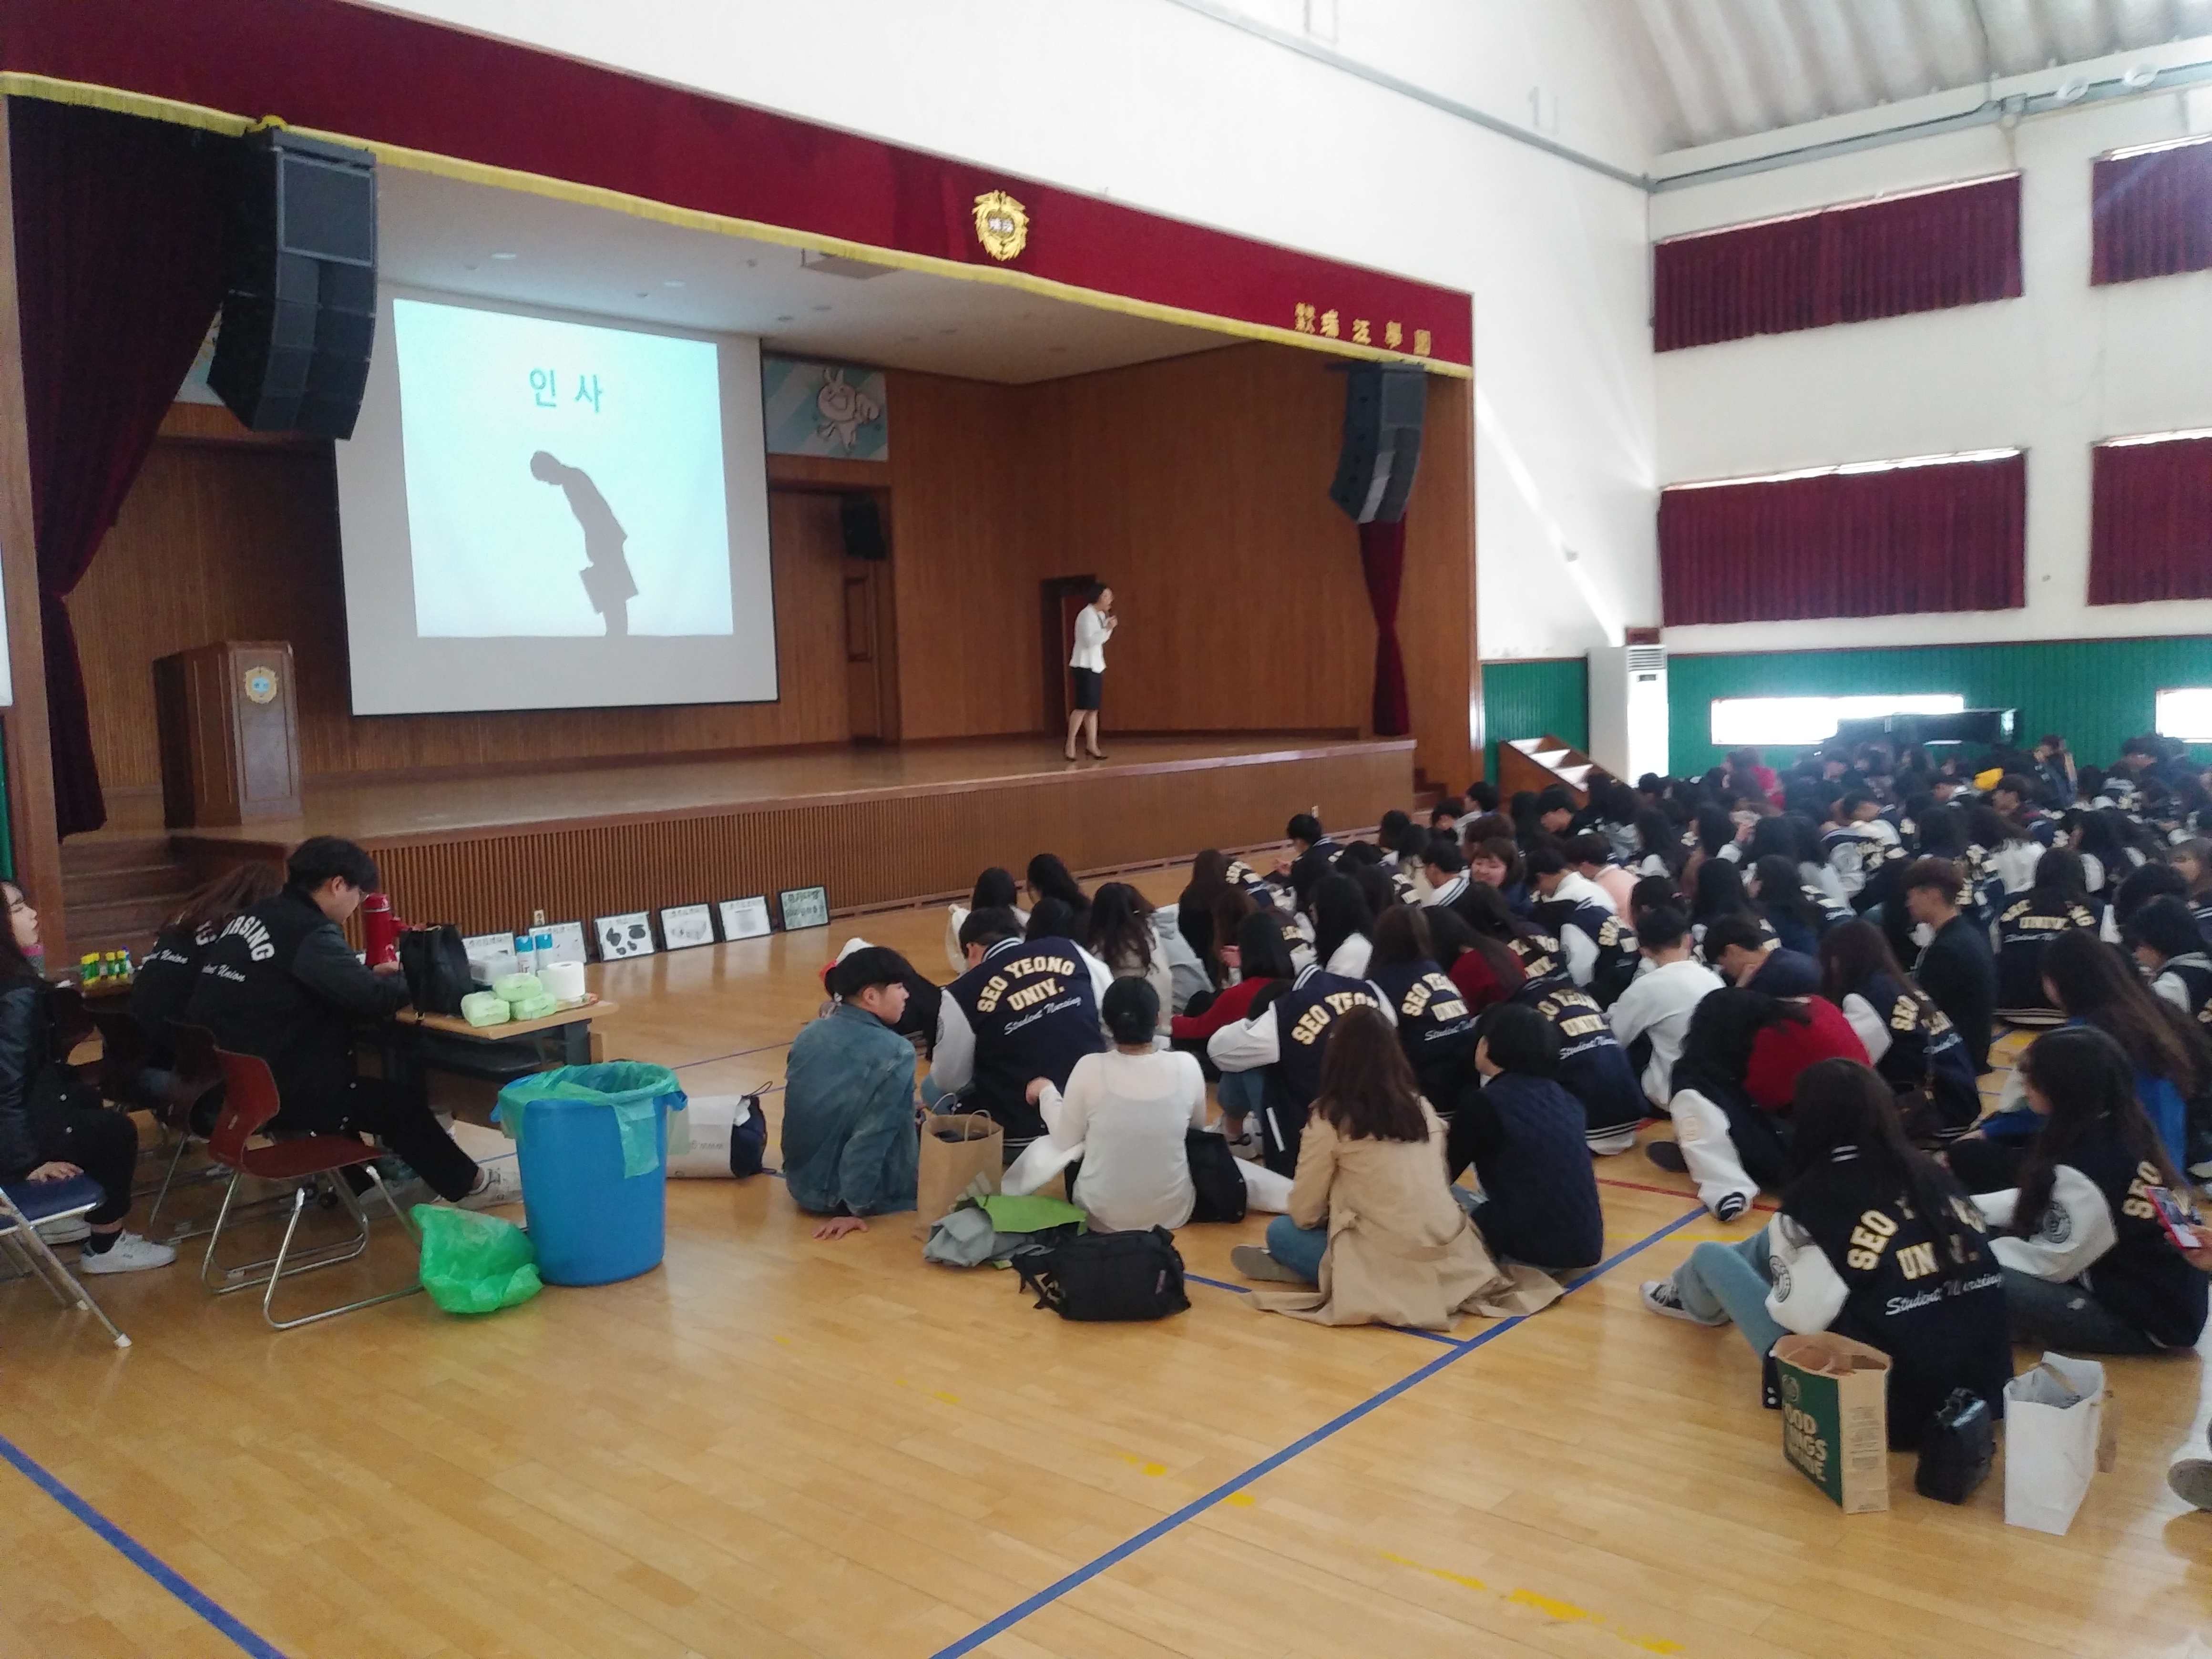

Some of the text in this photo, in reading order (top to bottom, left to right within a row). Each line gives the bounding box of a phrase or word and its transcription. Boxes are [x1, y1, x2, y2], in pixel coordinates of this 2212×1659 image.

[977, 956, 1076, 1013] SEO YEONG
[1006, 977, 1066, 1011] UNIV.
[1402, 983, 1432, 1016] SEO
[1291, 1004, 1331, 1045] SEO
[2123, 1161, 2162, 1219] SEO
[1846, 1209, 1899, 1270] SEO
